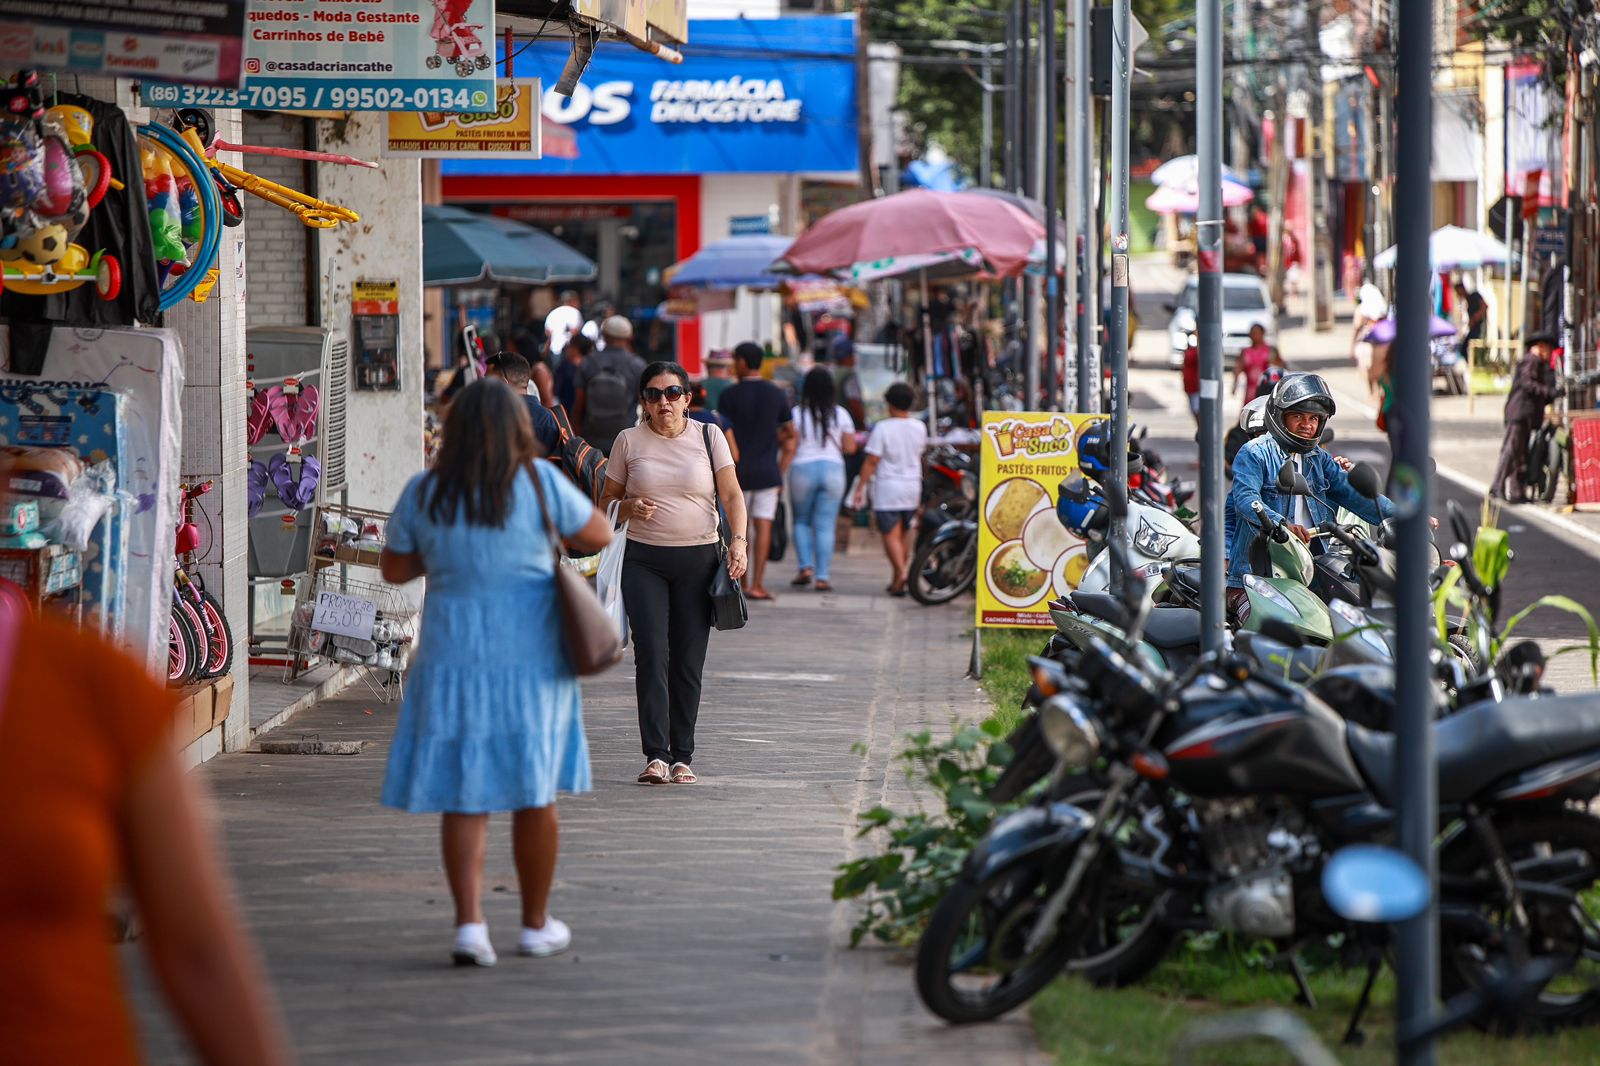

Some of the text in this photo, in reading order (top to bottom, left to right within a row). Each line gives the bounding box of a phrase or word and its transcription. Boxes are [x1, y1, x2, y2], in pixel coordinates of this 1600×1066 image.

[313, 11, 352, 22] Moda
[356, 11, 420, 23] Gestante
[253, 28, 385, 43] Carrinhos de Bebê
[264, 61, 393, 73] @casadacriancathe
[650, 76, 785, 101] FARMÁCIA
[149, 86, 470, 109] (86) 3223-7095 / 99502-0134
[650, 99, 802, 122] DRUGSTORE
[456, 130, 482, 138] PASTÉIS
[388, 141, 421, 150] SALGADOS
[428, 141, 449, 150] CALDO
[450, 142, 458, 150] DE
[459, 142, 480, 150] CARNE
[487, 142, 512, 150] CUSCUZ
[1013, 422, 1051, 440] Casa
[1026, 437, 1070, 456] Suco
[997, 462, 1033, 475] PASTÉIS
[1035, 464, 1068, 476] FRITOS
[318, 610, 362, 627] 15,00
